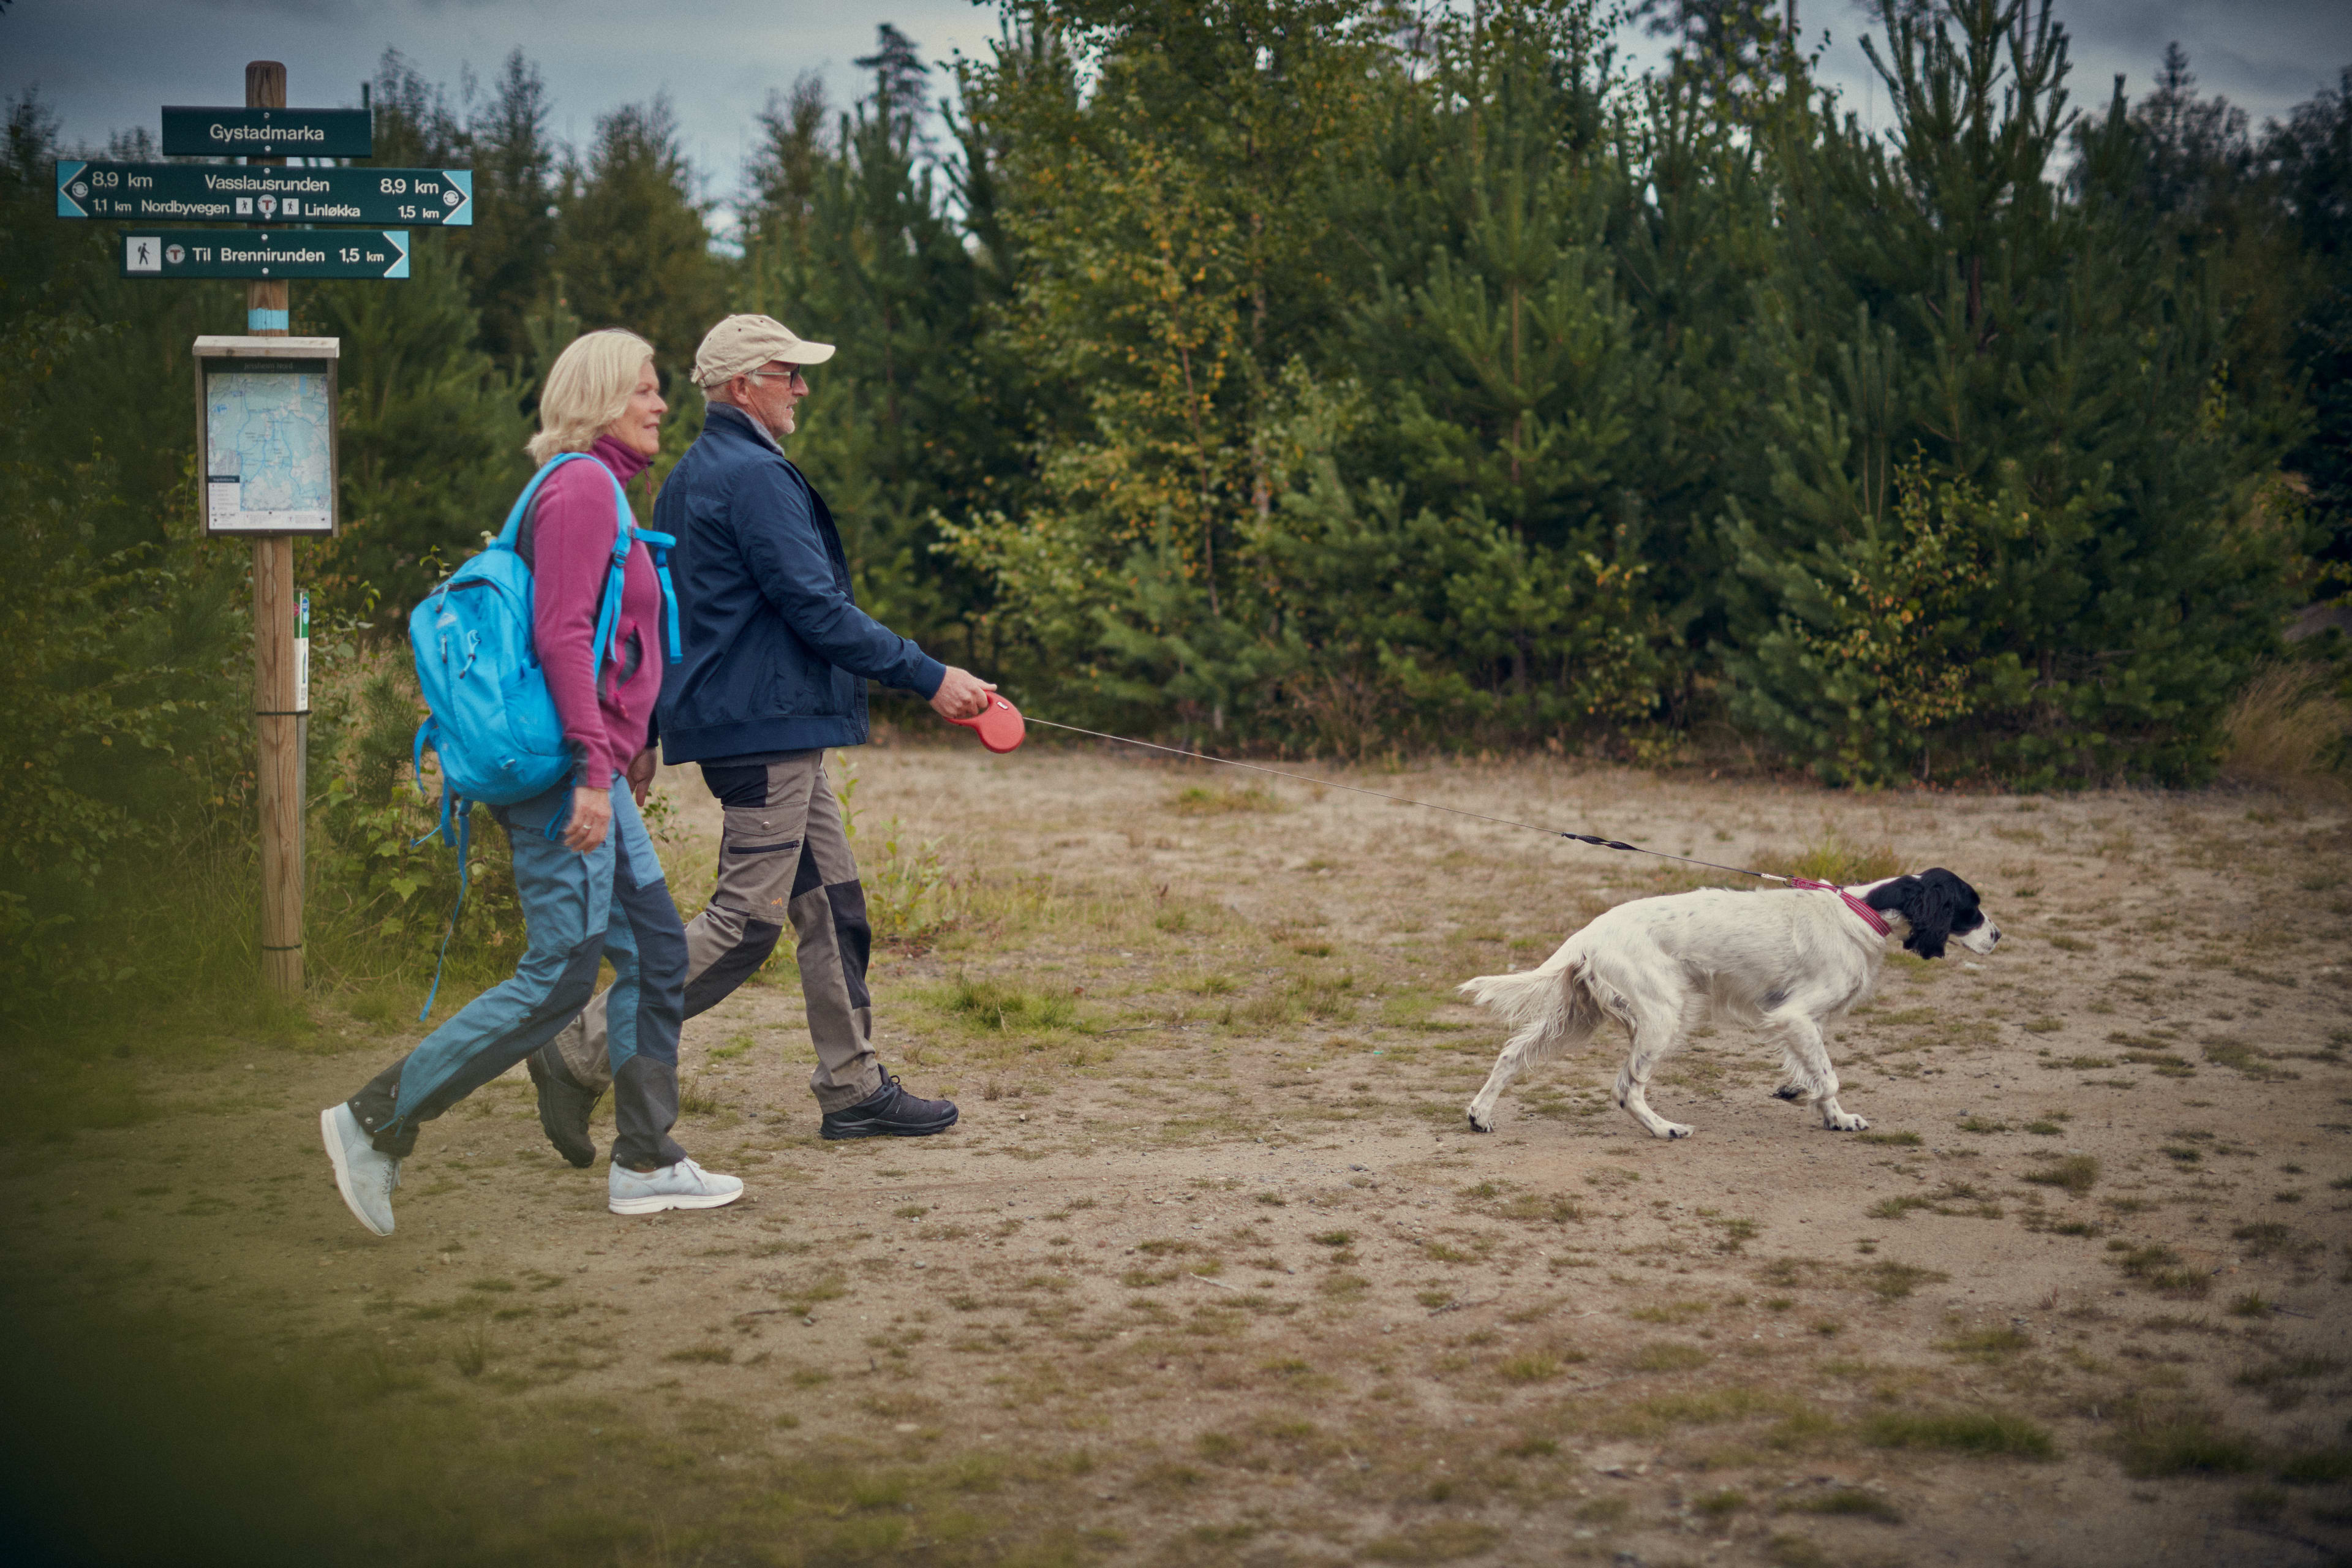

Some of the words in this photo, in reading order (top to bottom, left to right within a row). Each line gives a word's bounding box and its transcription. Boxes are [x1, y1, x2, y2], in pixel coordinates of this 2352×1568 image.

[209, 124, 325, 143] Gystadmarka
[92, 171, 119, 188] 8,9
[128, 172, 153, 187] km
[205, 174, 330, 192] Vasslausrunden
[380, 178, 407, 195] 8,9
[415, 179, 439, 194] km
[92, 198, 107, 212] 1,1
[115, 201, 132, 211] km
[141, 199, 230, 216] Nordbyvegen
[305, 203, 361, 217] Linløkka
[398, 205, 416, 219] 1,5
[423, 208, 439, 218] km
[192, 247, 211, 262] Til
[221, 247, 325, 262] Brennirunden
[339, 247, 360, 263] 1,5
[367, 251, 385, 262] km
